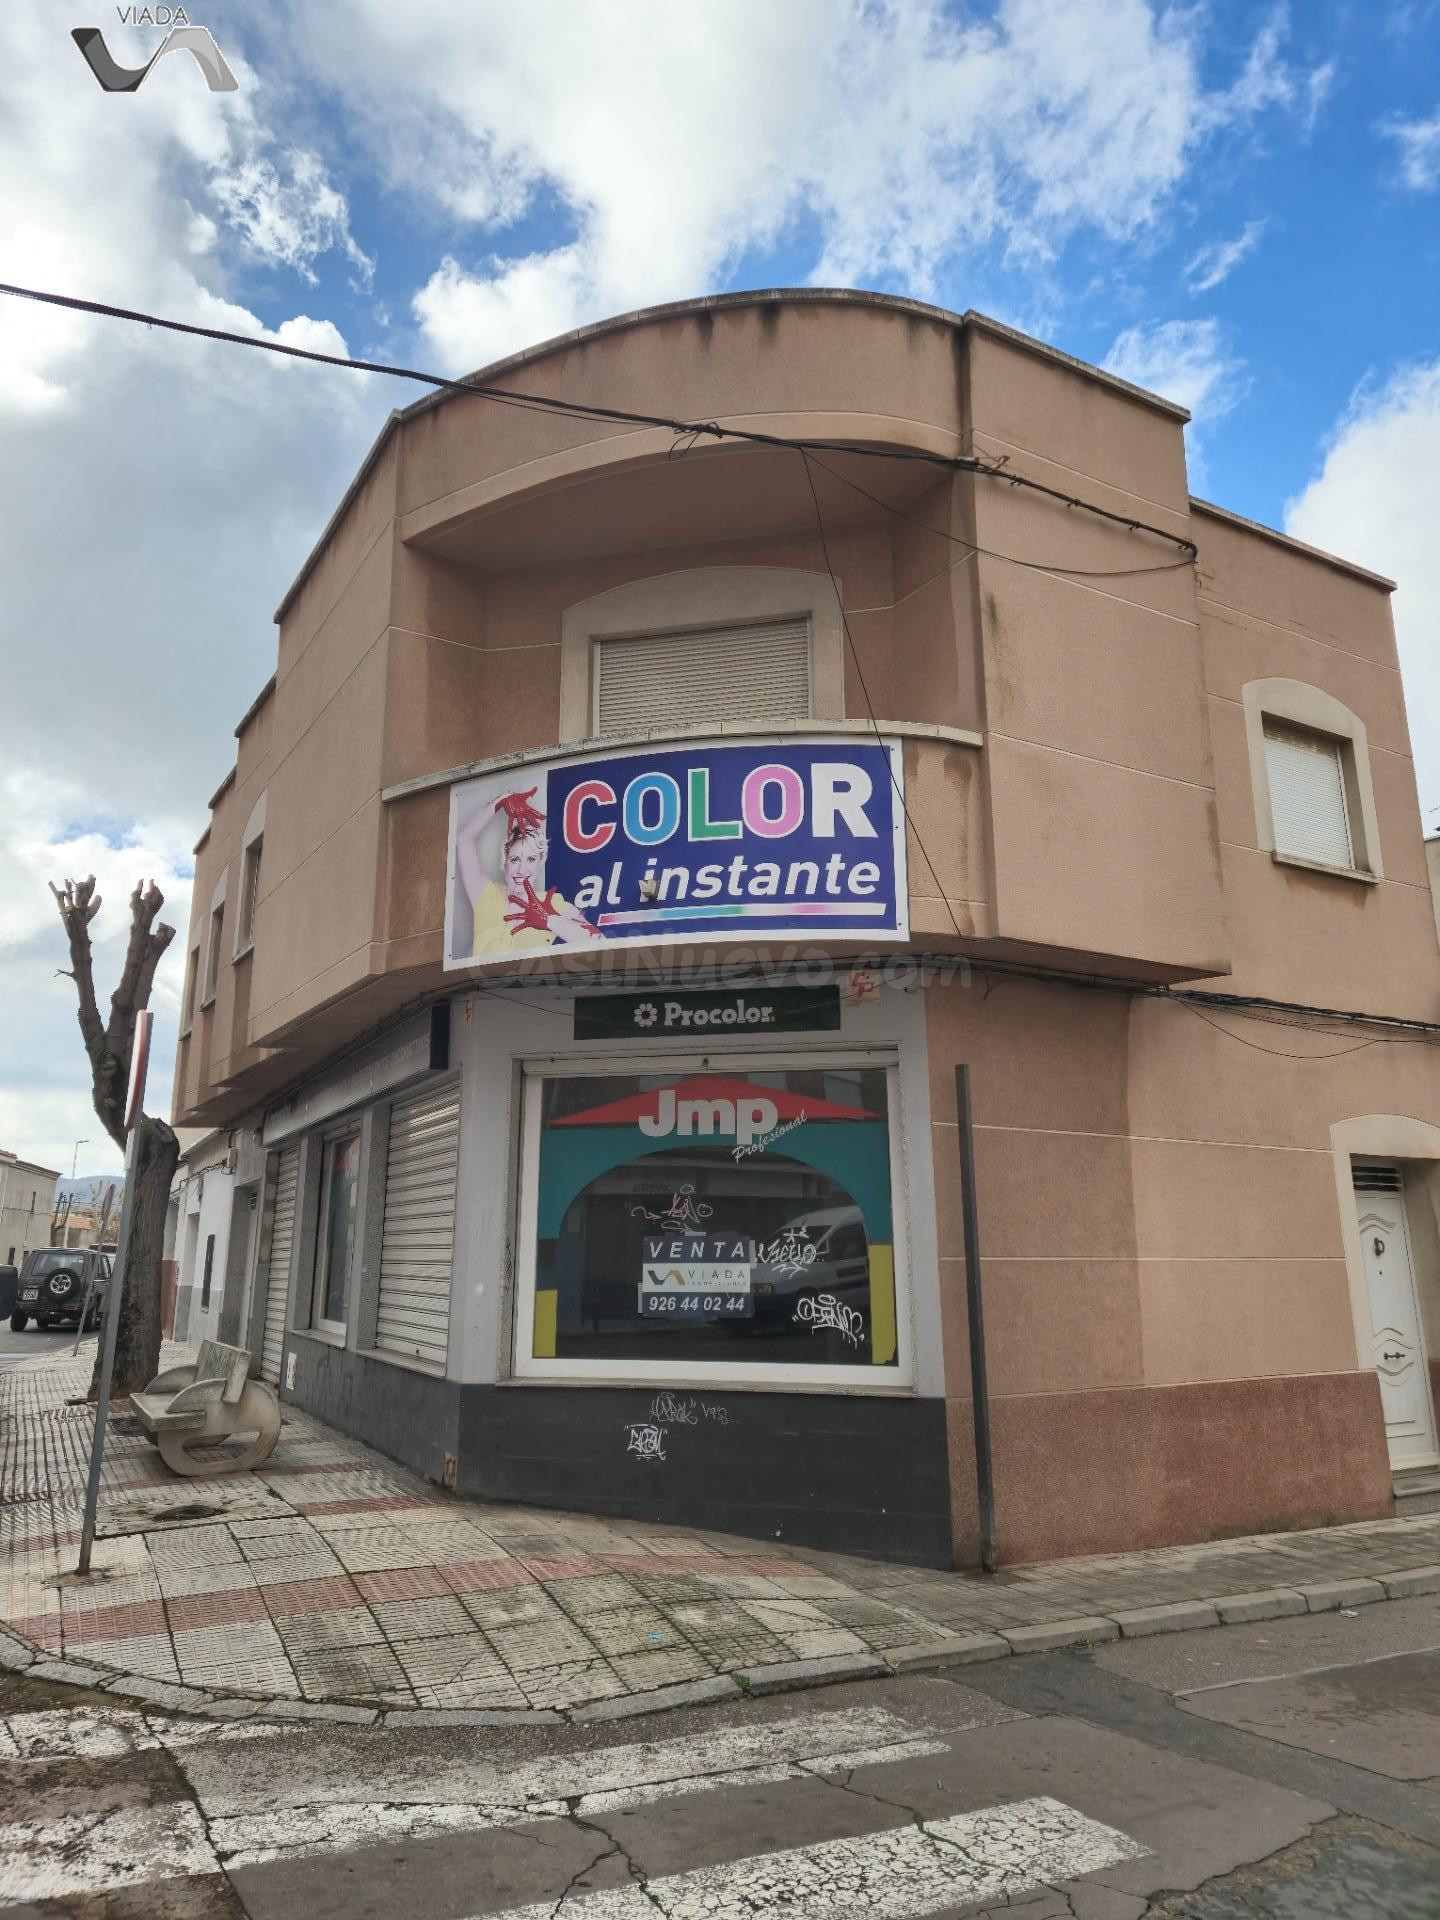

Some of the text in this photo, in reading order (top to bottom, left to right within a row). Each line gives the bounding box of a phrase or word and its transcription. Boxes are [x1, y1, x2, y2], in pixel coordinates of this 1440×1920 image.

[563, 762, 879, 854] COLOR
[574, 853, 881, 909] al instante
[664, 999, 773, 1027] Procolor
[638, 1089, 779, 1145] Jmp
[732, 1109, 808, 1163] Profesional
[649, 1241, 745, 1259] VENTA
[688, 1269, 745, 1280] VIADA
[649, 1296, 745, 1312] 926 44 02 44
